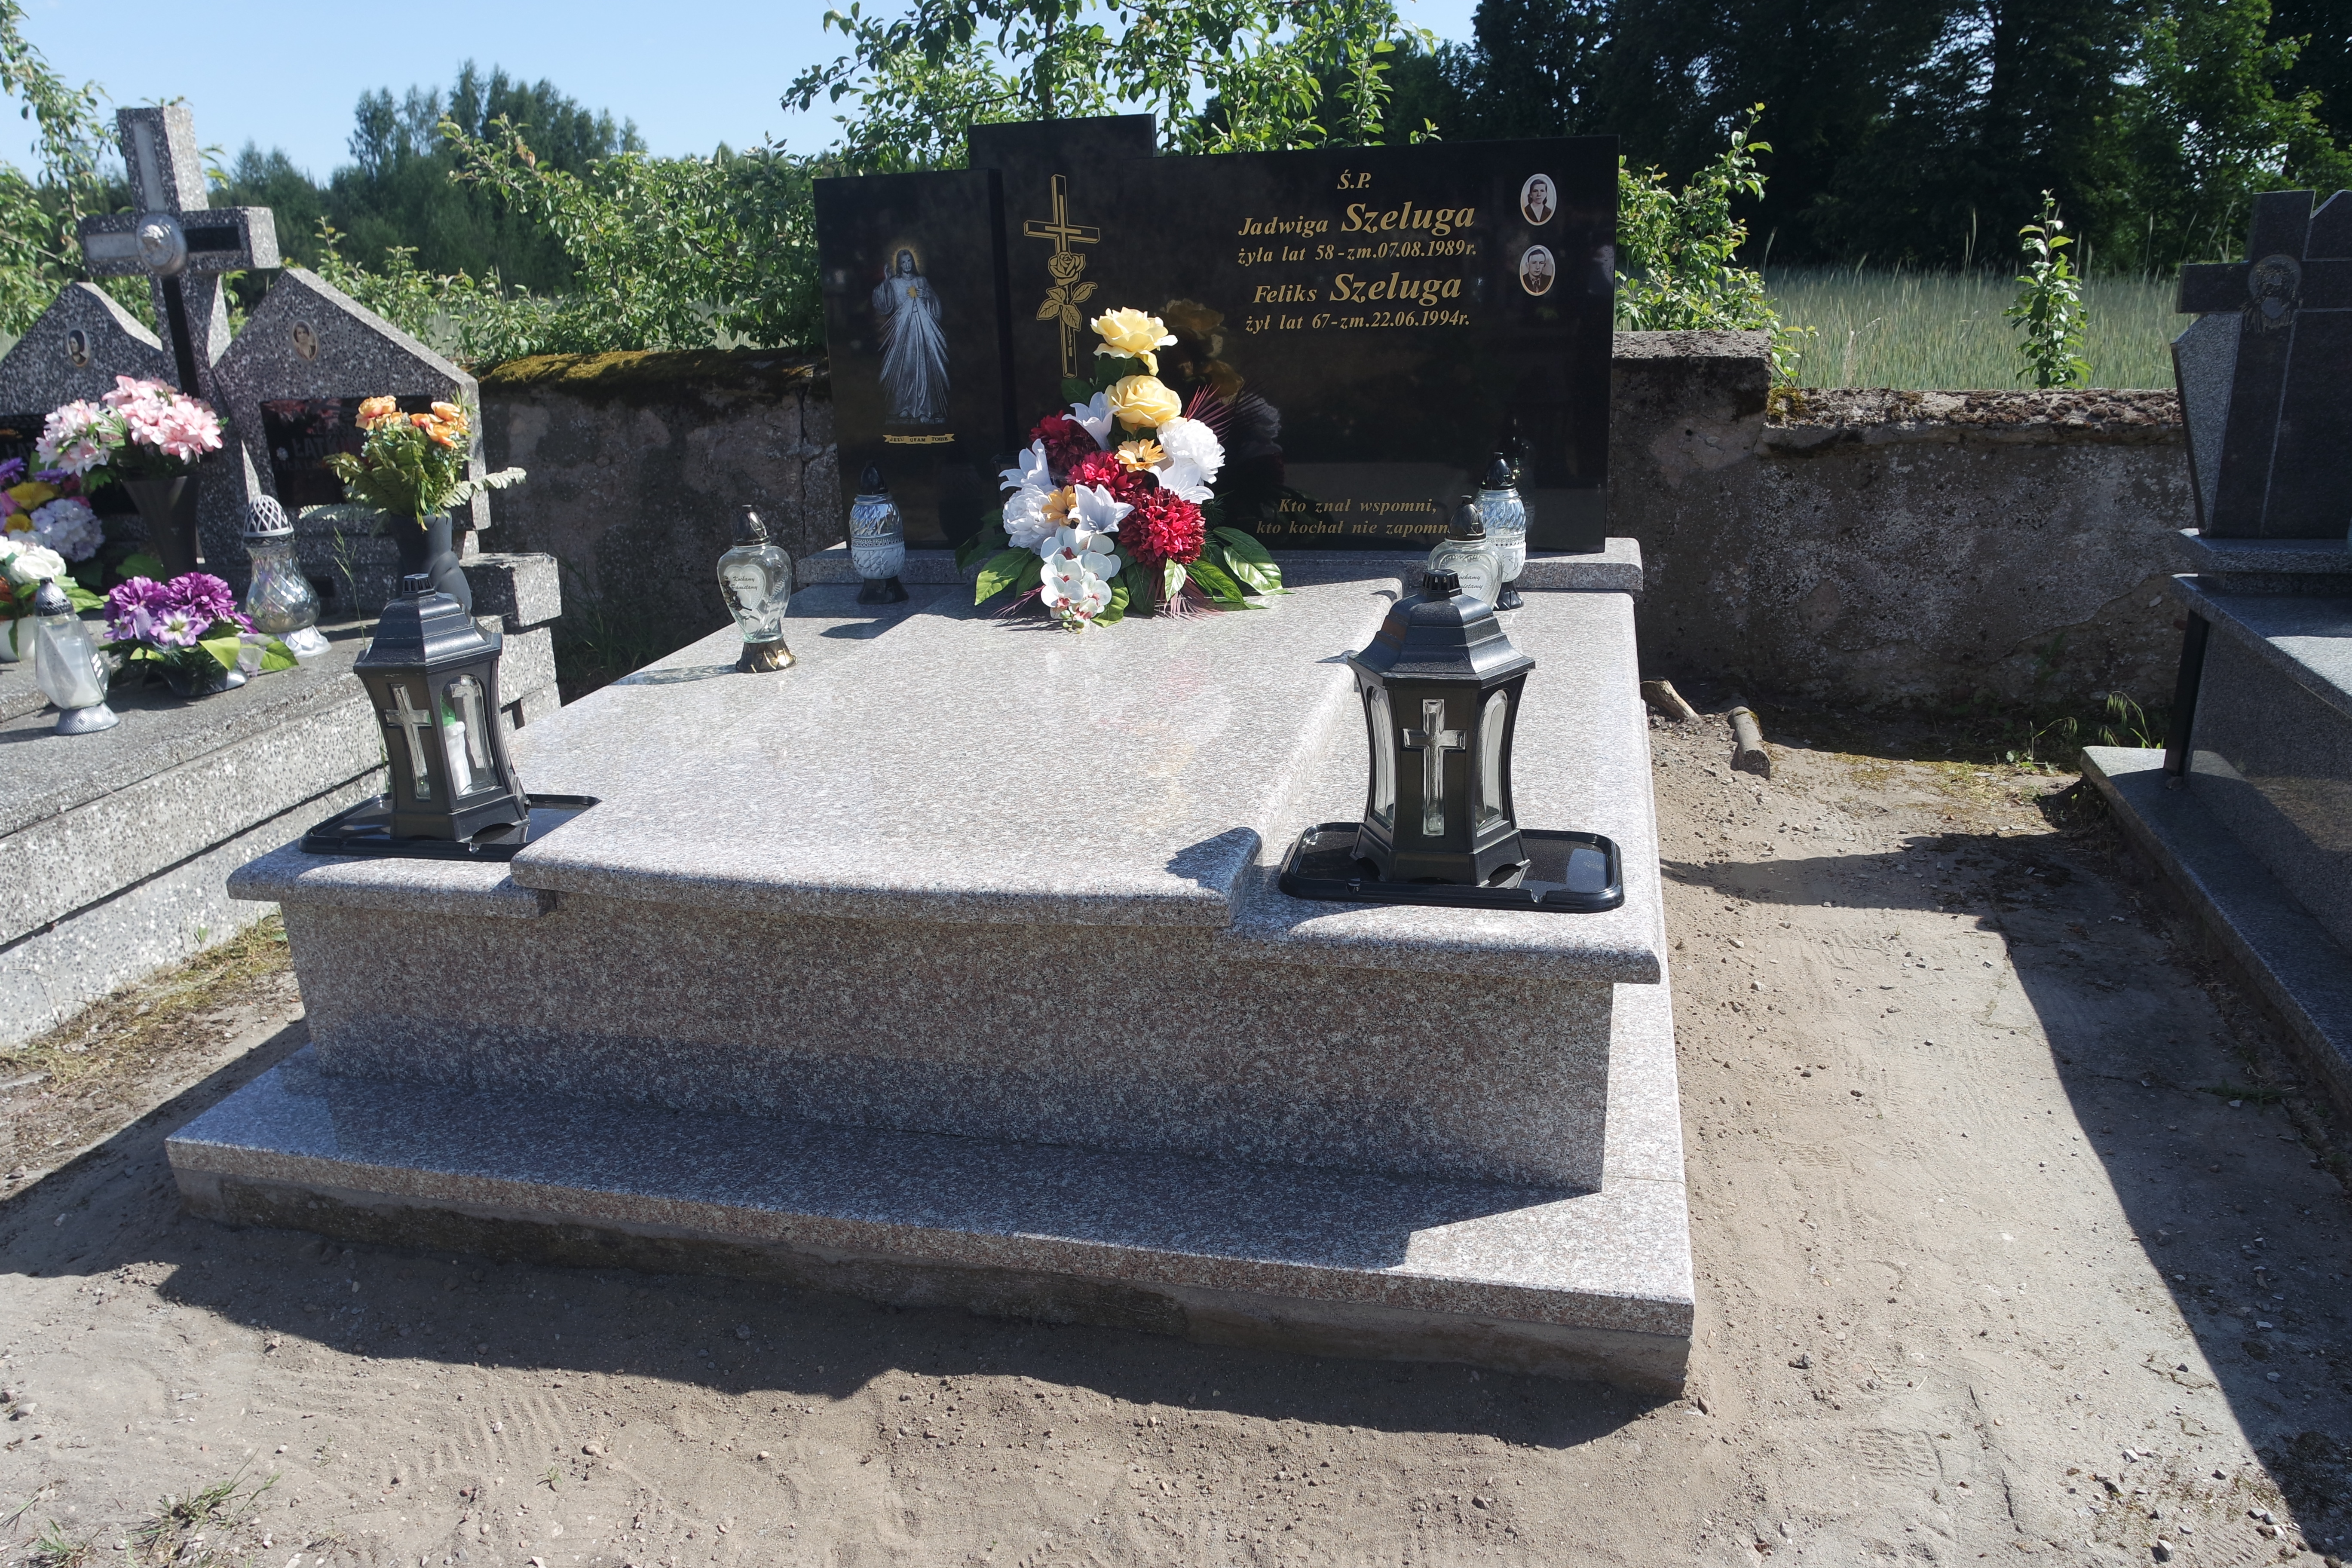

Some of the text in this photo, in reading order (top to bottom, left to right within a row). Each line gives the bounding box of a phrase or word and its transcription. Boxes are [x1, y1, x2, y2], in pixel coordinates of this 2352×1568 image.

[1337, 169, 1371, 190] Ś.P.
[1238, 201, 1475, 238] Jadwiga Szeluga
[1237, 247, 1273, 267] żyła
[1282, 246, 1306, 261] lat
[1252, 272, 1461, 306] Feliks Szeluga
[1245, 315, 1271, 334] żył
[1280, 314, 1303, 330] lat
[1278, 498, 1436, 516] Kto znał wspomni,
[1256, 520, 1448, 537] kto kochał nie zapomn
